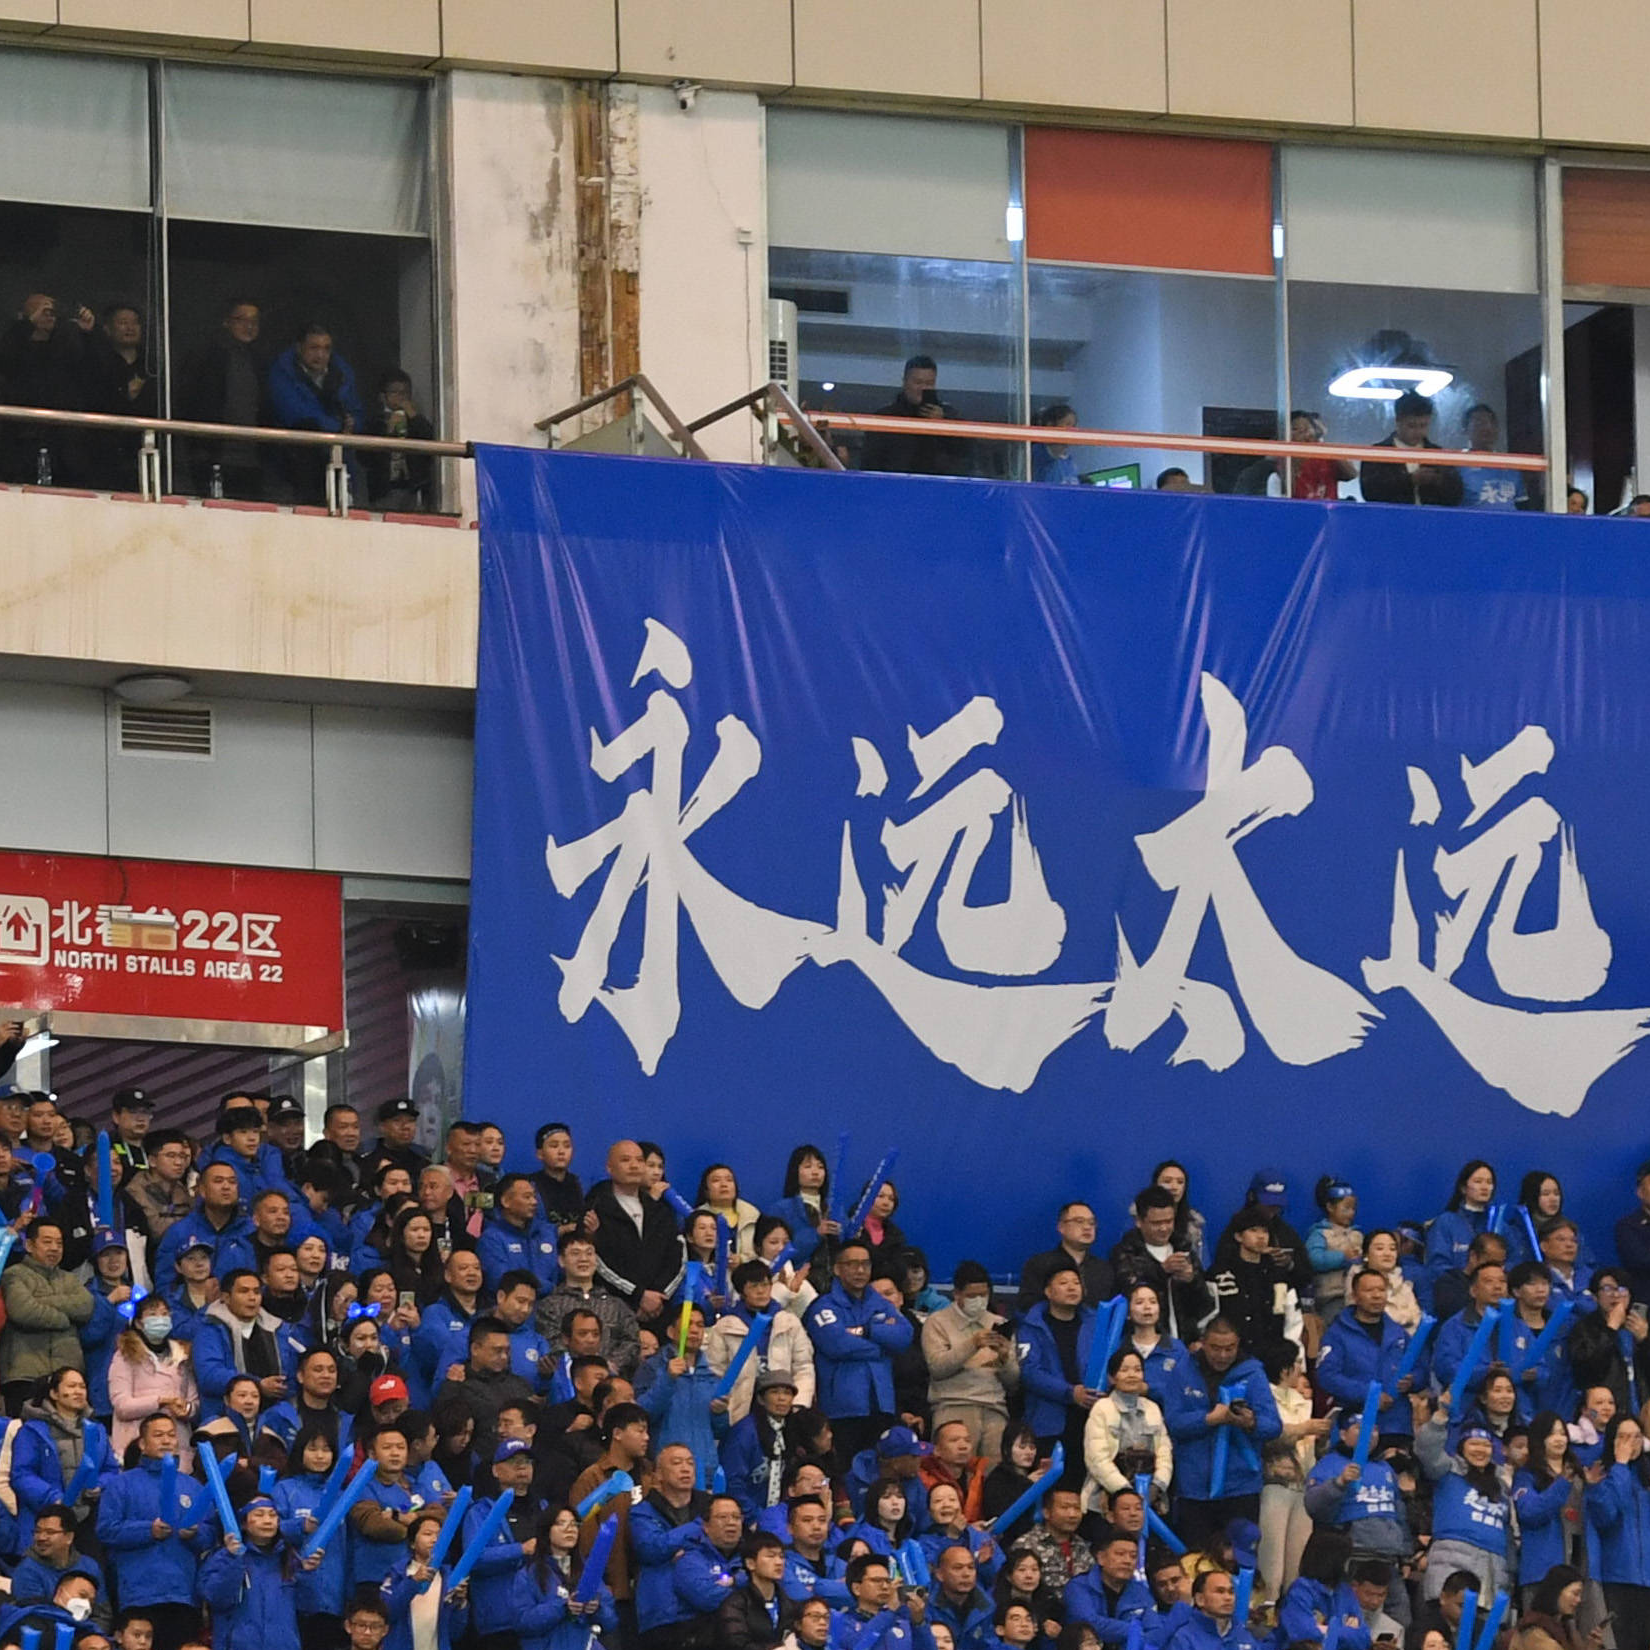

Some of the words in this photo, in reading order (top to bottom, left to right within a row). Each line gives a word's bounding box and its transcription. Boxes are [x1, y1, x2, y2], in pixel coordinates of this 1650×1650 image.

[53, 949, 119, 972] NORTH
[125, 954, 196, 977] STALLS
[203, 960, 253, 980] AREA
[258, 964, 284, 983] 22
